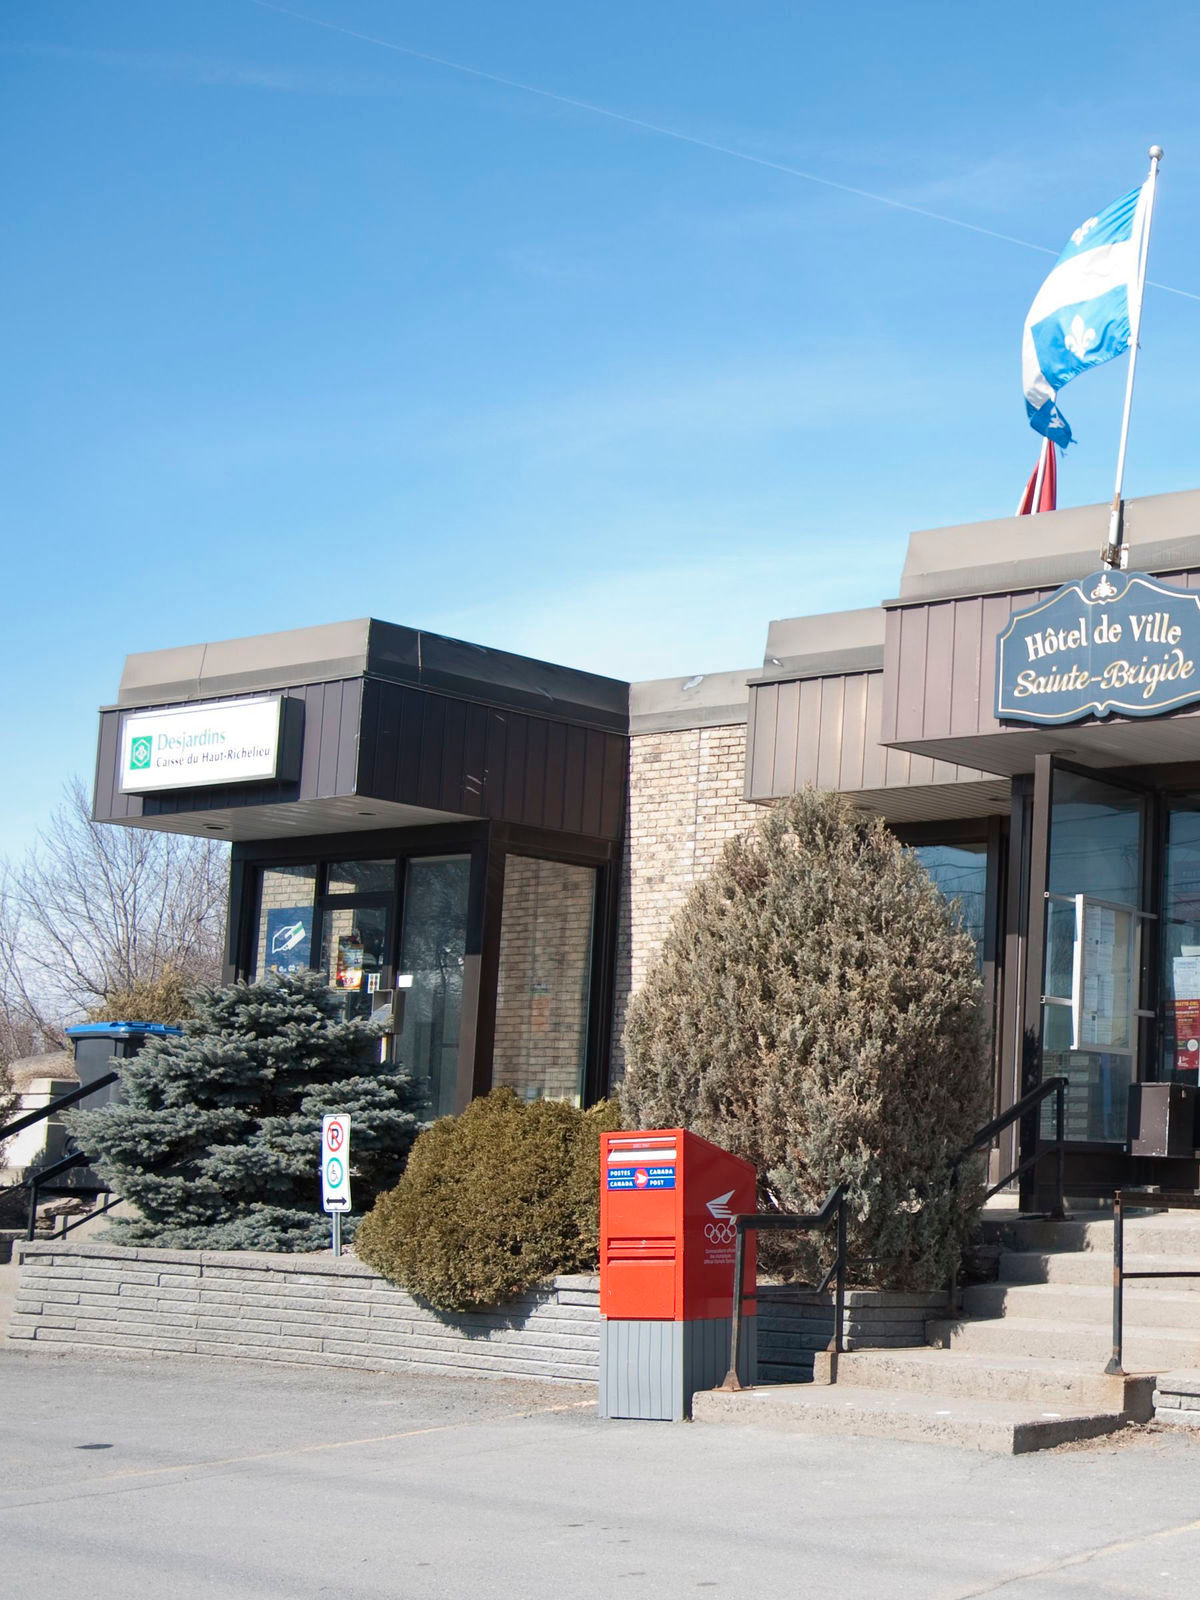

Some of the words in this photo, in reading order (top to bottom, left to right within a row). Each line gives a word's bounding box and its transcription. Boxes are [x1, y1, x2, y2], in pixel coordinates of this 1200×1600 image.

[1024, 617, 1088, 663] Hôtel
[1093, 614, 1122, 645] de
[1129, 612, 1182, 646] Ville
[1013, 647, 1196, 699] Sainte-Brigide
[156, 757, 184, 767] Caisse
[187, 753, 199, 764] du
[202, 746, 270, 763] Haut-Richelieu
[157, 728, 226, 752] Desjardins
